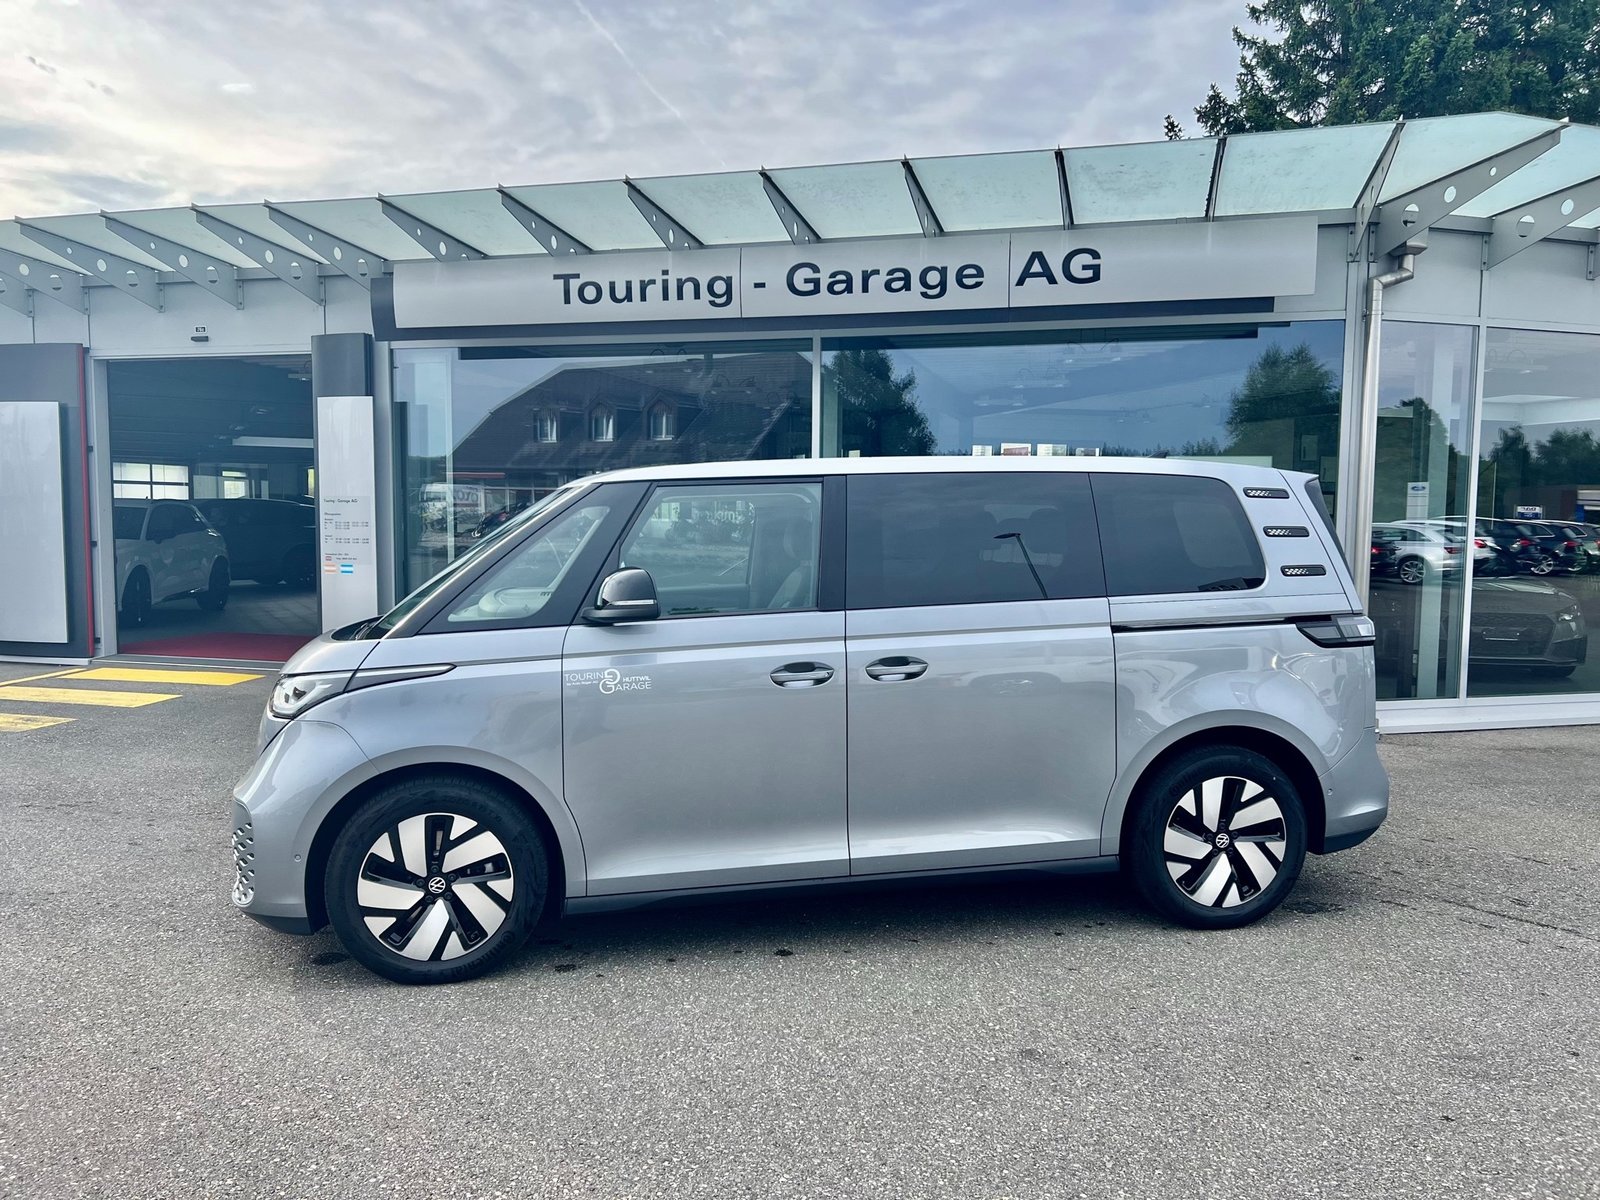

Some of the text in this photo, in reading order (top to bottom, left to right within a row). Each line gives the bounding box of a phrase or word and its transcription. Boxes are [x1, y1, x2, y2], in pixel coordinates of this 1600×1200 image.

[553, 247, 1102, 308] Touring - Garage AG
[622, 675, 652, 683] HUTTWIL
